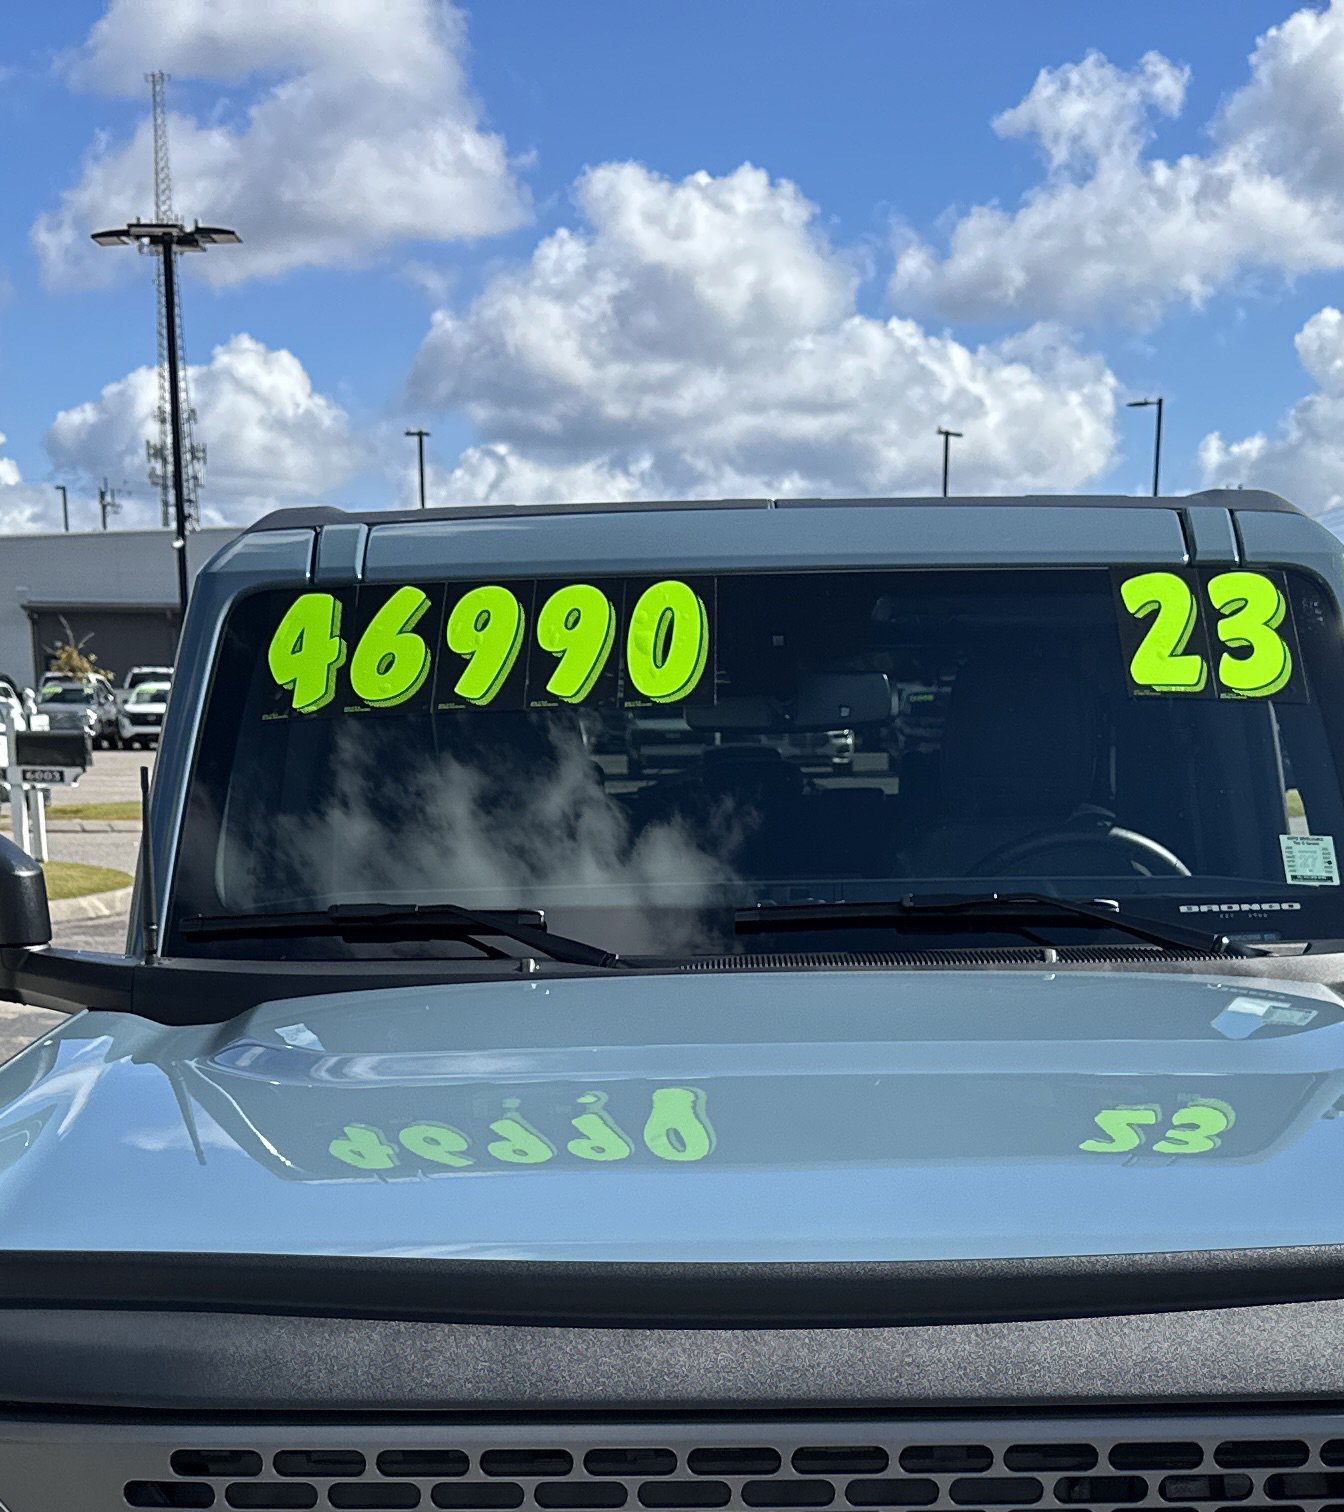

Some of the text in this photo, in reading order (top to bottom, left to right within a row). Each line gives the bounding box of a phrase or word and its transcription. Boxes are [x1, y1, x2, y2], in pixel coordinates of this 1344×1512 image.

[267, 580, 709, 713] 46990
[1120, 571, 1292, 697] 23
[1178, 902, 1302, 913] BRONCO
